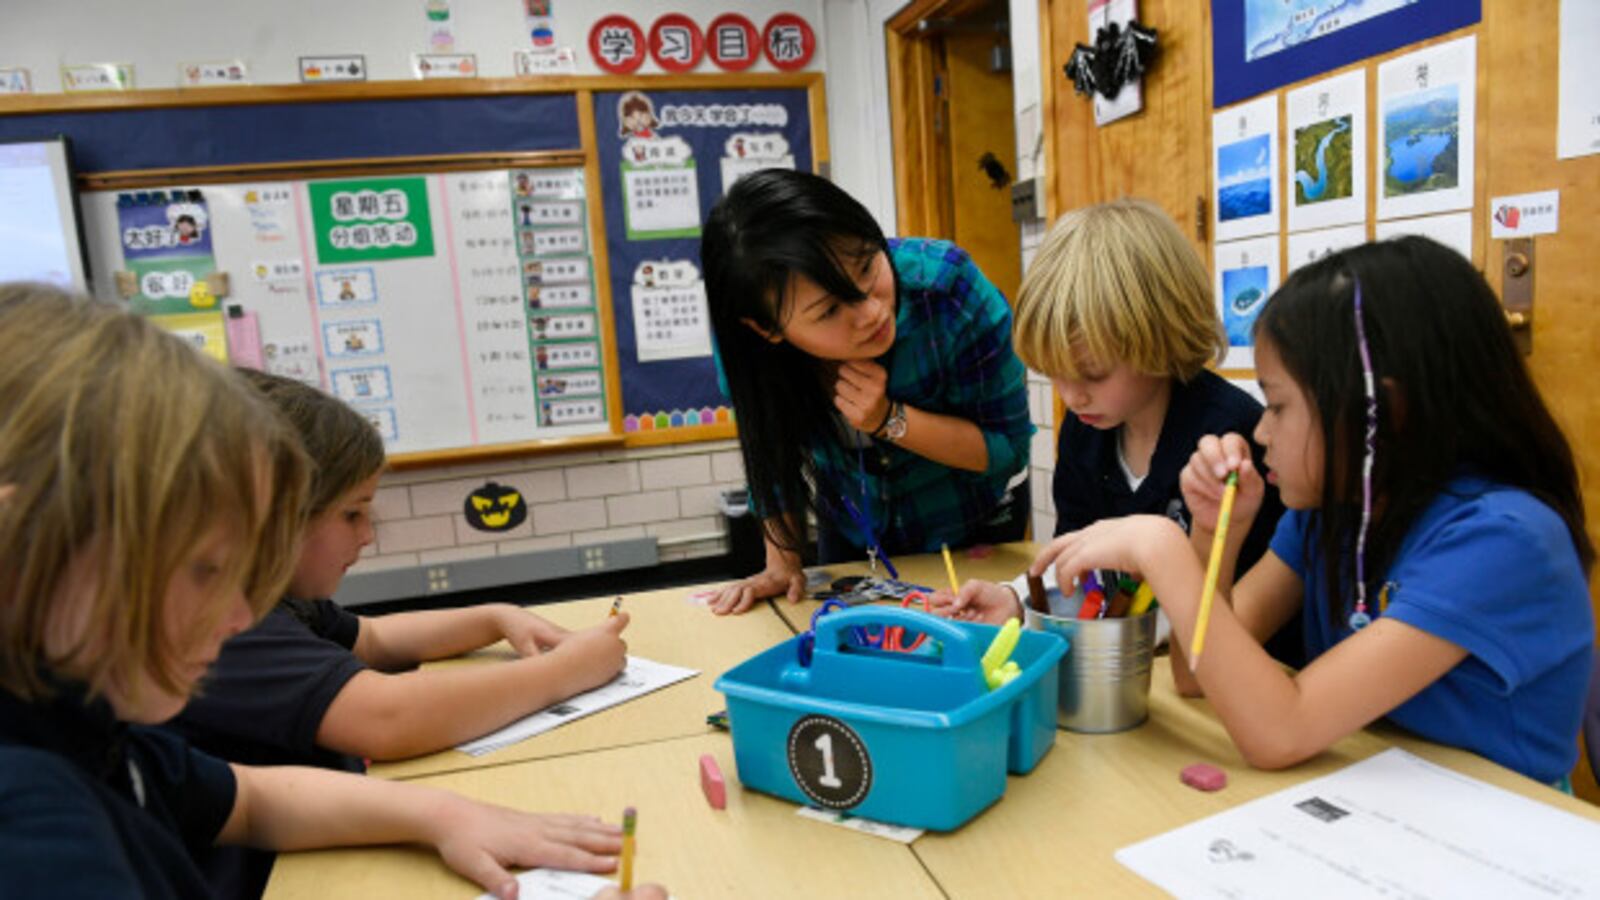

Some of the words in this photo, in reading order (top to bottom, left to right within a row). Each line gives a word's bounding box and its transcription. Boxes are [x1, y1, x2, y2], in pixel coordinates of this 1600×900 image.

[602, 27, 802, 62] 学习目标
[336, 193, 403, 216] 星期五
[333, 225, 413, 247] 分组活动
[814, 733, 842, 788] 1
